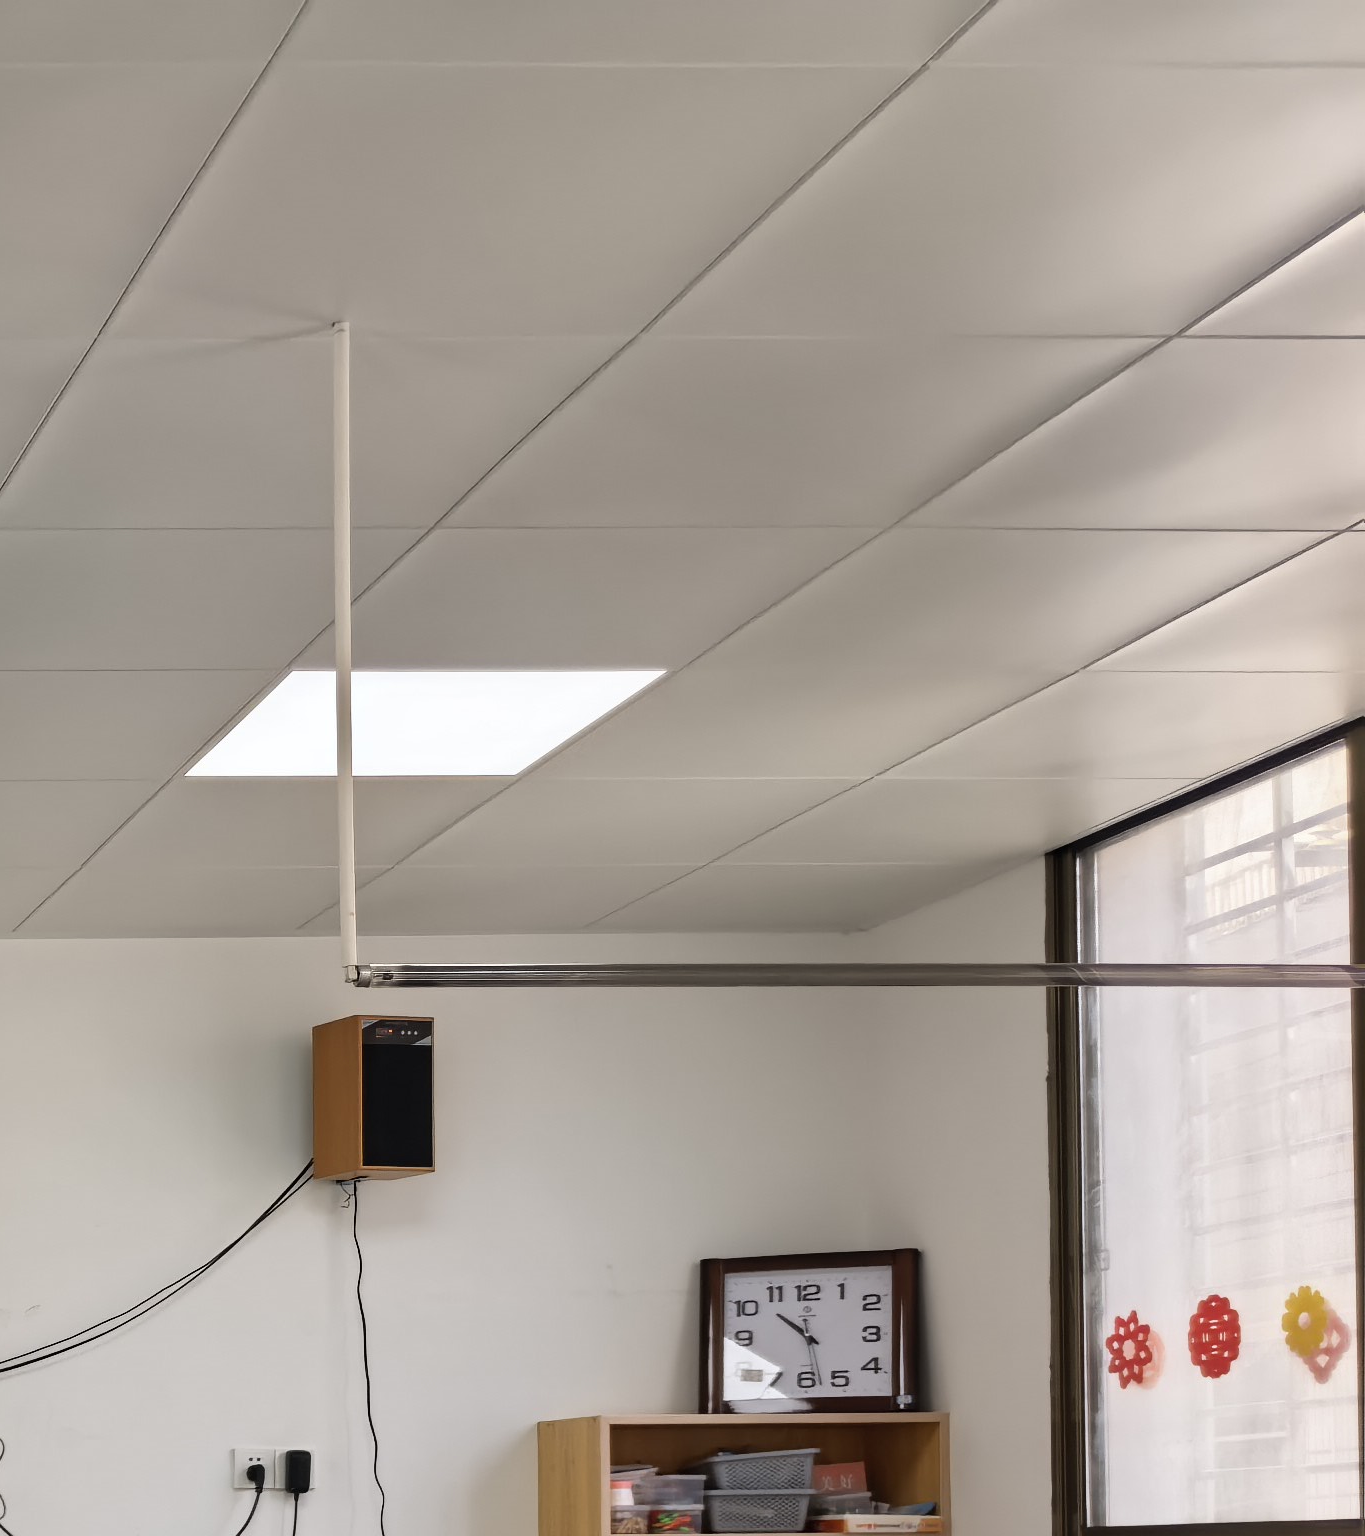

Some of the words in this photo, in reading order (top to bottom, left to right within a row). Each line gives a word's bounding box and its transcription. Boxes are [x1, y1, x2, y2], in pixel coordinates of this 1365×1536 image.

[766, 1285, 783, 1303] 11
[794, 1284, 821, 1302] 12
[837, 1283, 845, 1300] 1
[734, 1300, 759, 1317] 10
[862, 1294, 881, 1312] 2
[734, 1330, 754, 1346] 9
[862, 1325, 882, 1343] 3
[861, 1357, 883, 1374] 4
[797, 1371, 816, 1388] 6
[830, 1370, 850, 1387] 5
